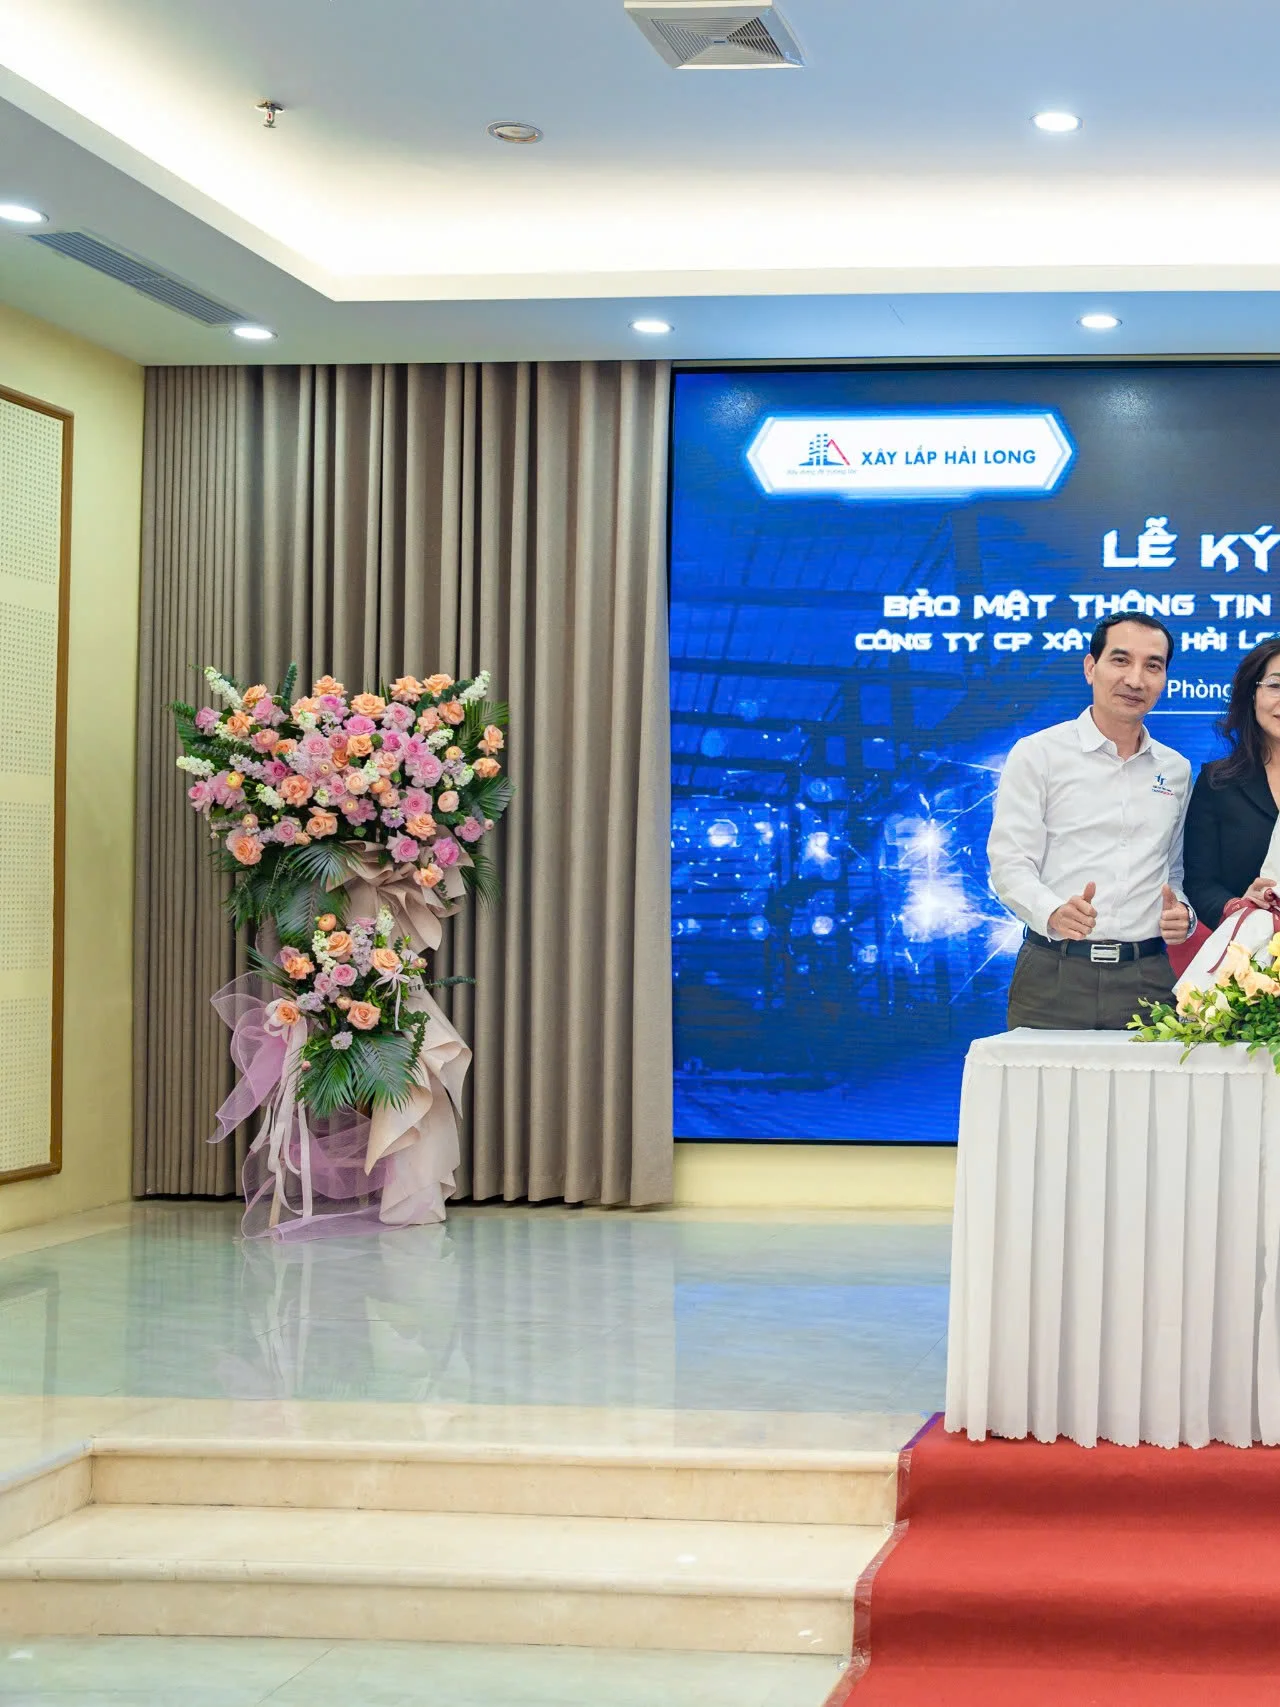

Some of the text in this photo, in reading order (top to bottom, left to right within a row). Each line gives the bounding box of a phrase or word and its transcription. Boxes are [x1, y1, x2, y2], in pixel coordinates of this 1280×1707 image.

[861, 447, 897, 466] XÂY
[944, 445, 977, 465] HẢI
[984, 449, 1036, 465] LONG
[1103, 517, 1177, 568] LỄ
[883, 588, 961, 620] BẢO
[973, 589, 1056, 621] MẬT
[1069, 589, 1195, 619] THÔNG
[1210, 594, 1272, 619] TIN
[855, 628, 932, 653] CÔNG
[942, 632, 984, 653] TY
[993, 632, 1033, 652] CP
[1181, 626, 1228, 652] HẢI
